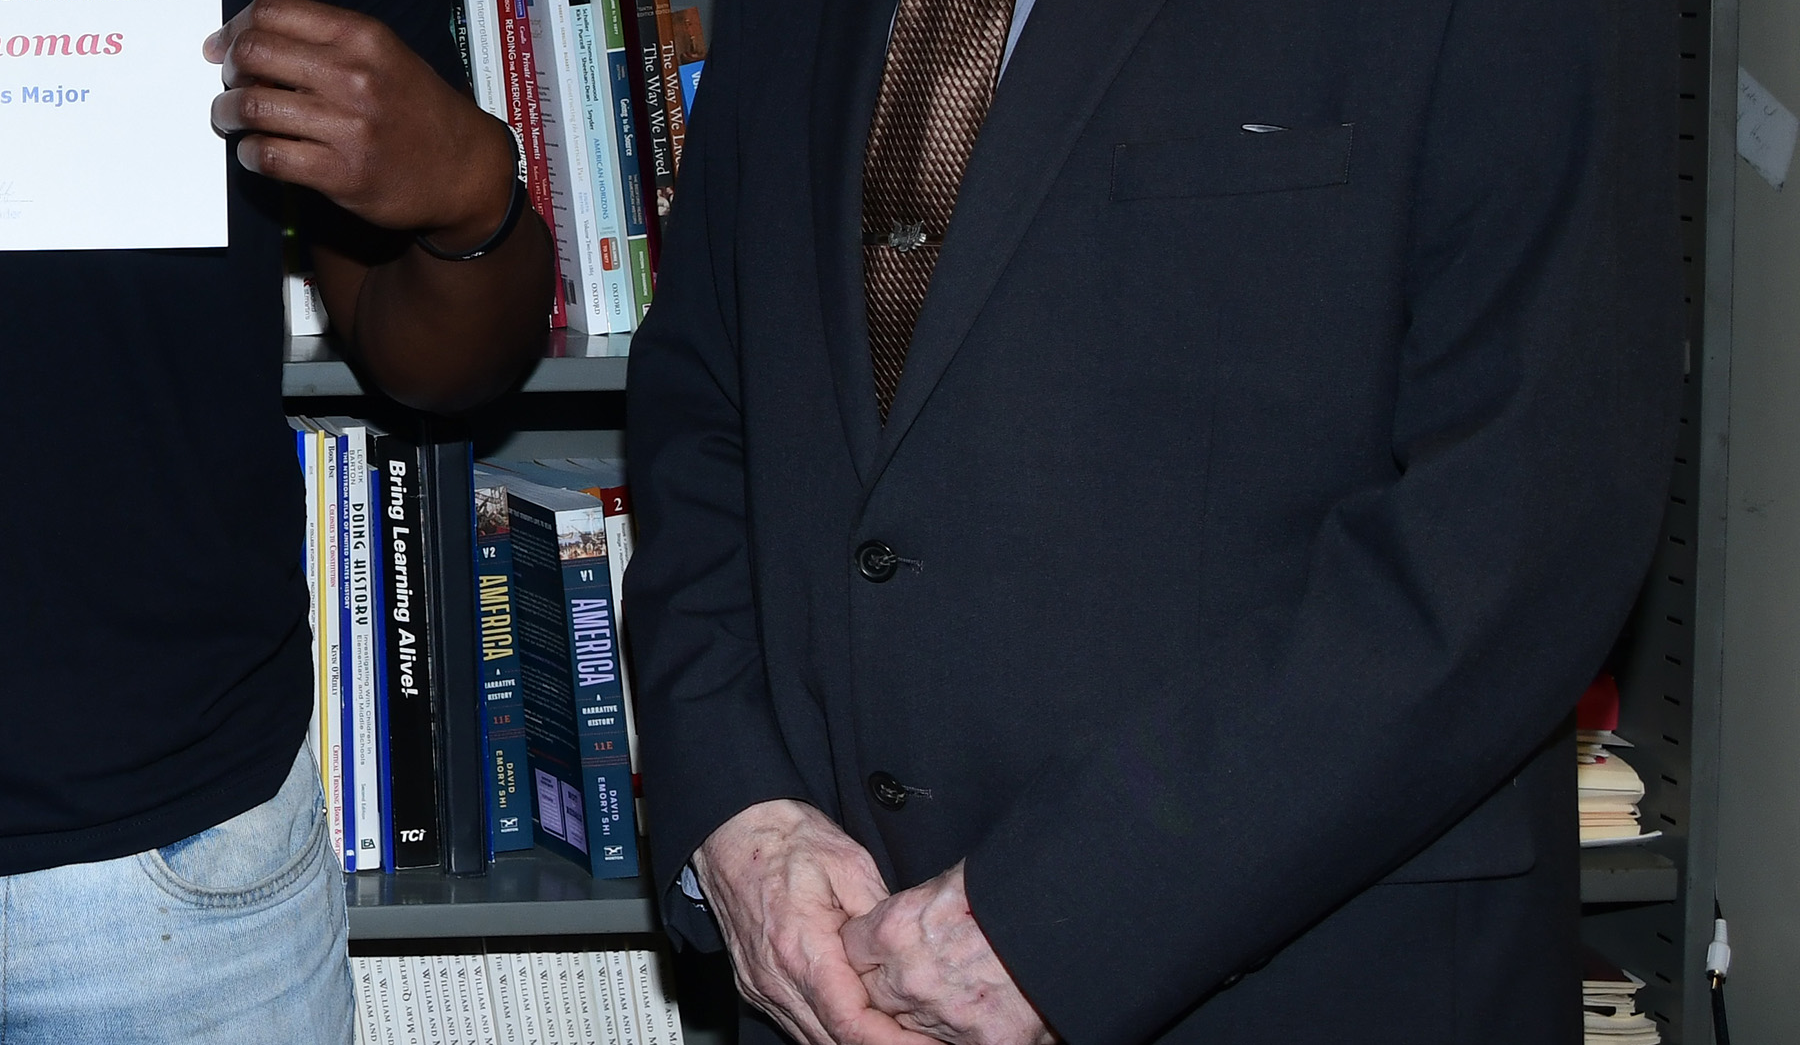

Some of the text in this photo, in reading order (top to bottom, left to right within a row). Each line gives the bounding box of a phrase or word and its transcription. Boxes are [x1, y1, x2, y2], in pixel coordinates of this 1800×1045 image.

[21, 85, 91, 108] Major
[643, 42, 670, 177] The Way We Lived
[352, 503, 368, 626] DOING HISTORY
[388, 459, 419, 698] Bring Learning Alive!
[479, 574, 514, 661] AMERICA
[571, 598, 615, 687] AMERICA
